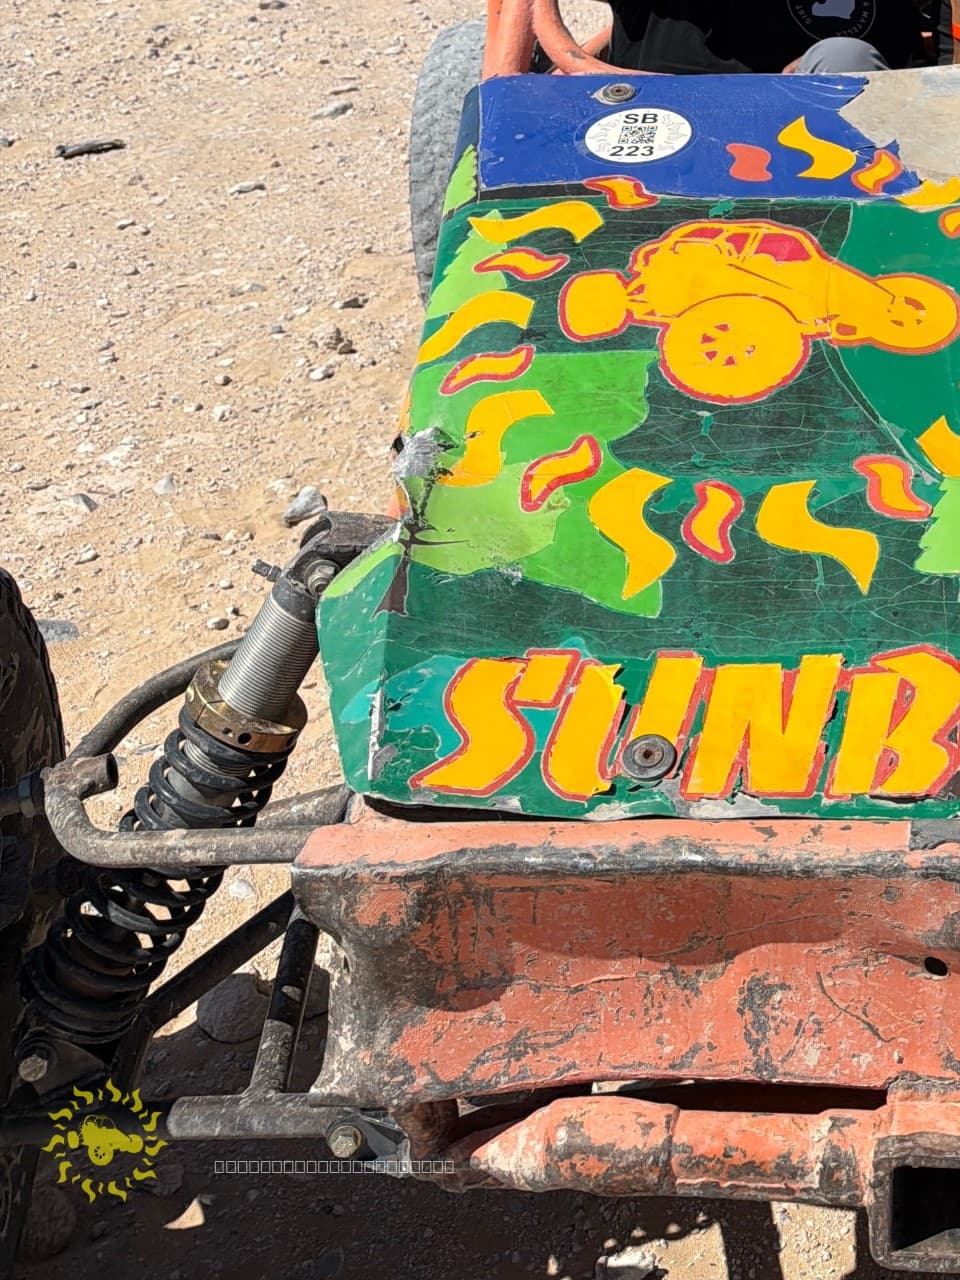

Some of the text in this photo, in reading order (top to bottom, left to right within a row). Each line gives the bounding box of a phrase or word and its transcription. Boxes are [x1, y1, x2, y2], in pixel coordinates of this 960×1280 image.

[794, 4, 812, 25] DIRT
[623, 113, 658, 124] SB
[609, 145, 654, 157] 223
